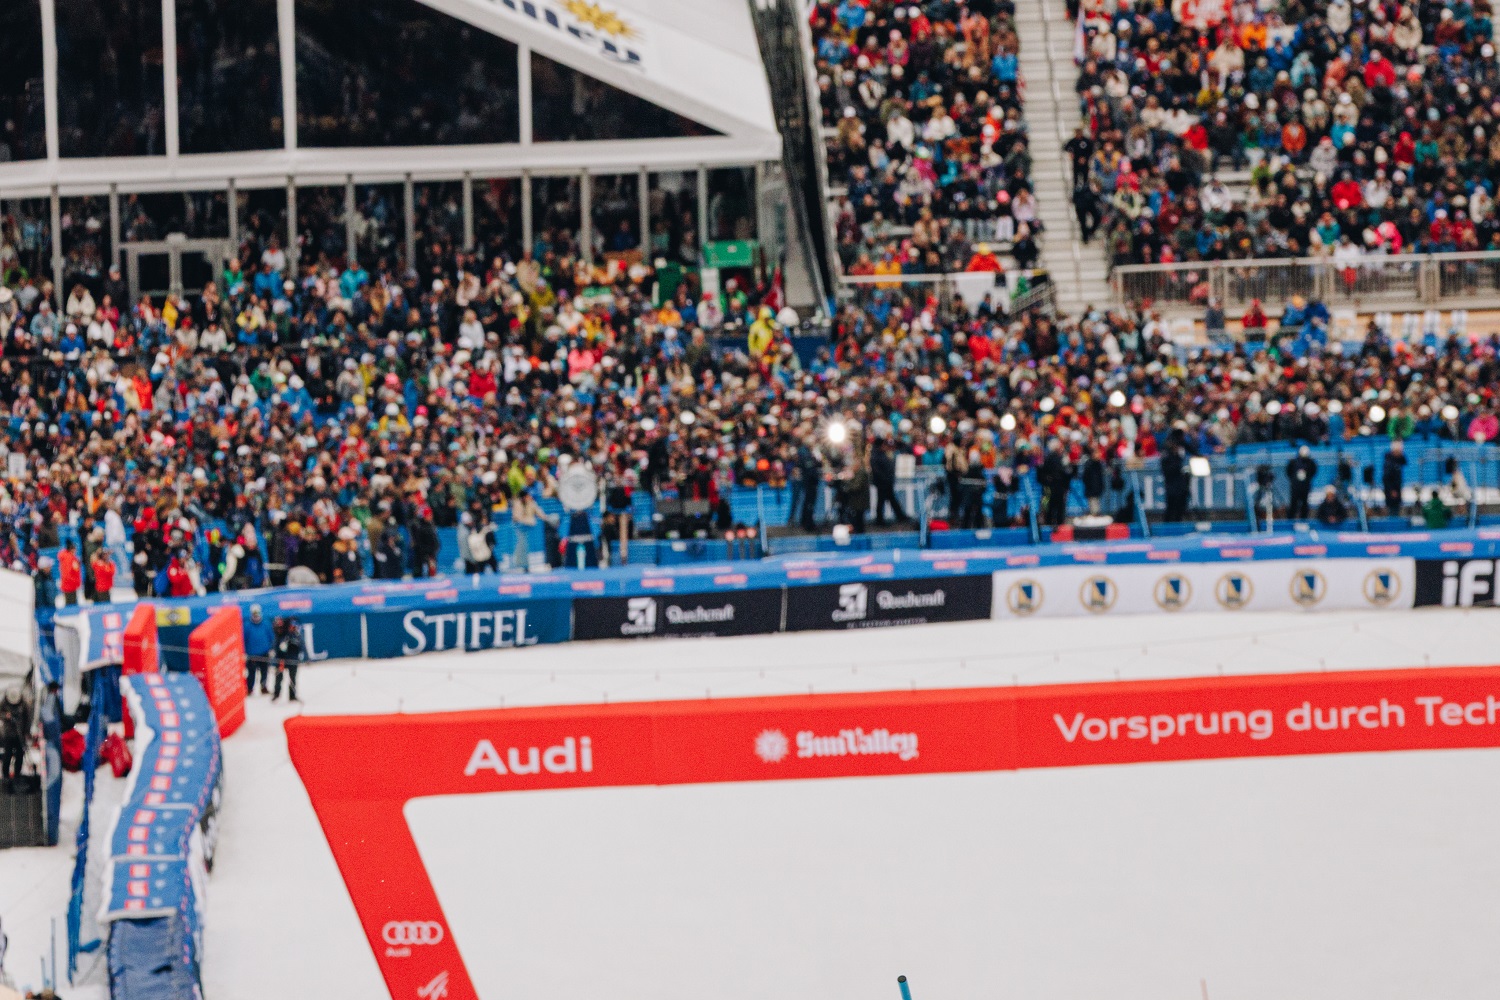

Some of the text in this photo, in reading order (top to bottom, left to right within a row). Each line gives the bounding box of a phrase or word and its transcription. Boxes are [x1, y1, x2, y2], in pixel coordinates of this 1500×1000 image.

[401, 609, 539, 656] STIFEL
[1052, 705, 1275, 744] Vorsprung
[1285, 699, 1406, 732] durch
[463, 736, 594, 777] Audi
[795, 728, 920, 761] SunValley
